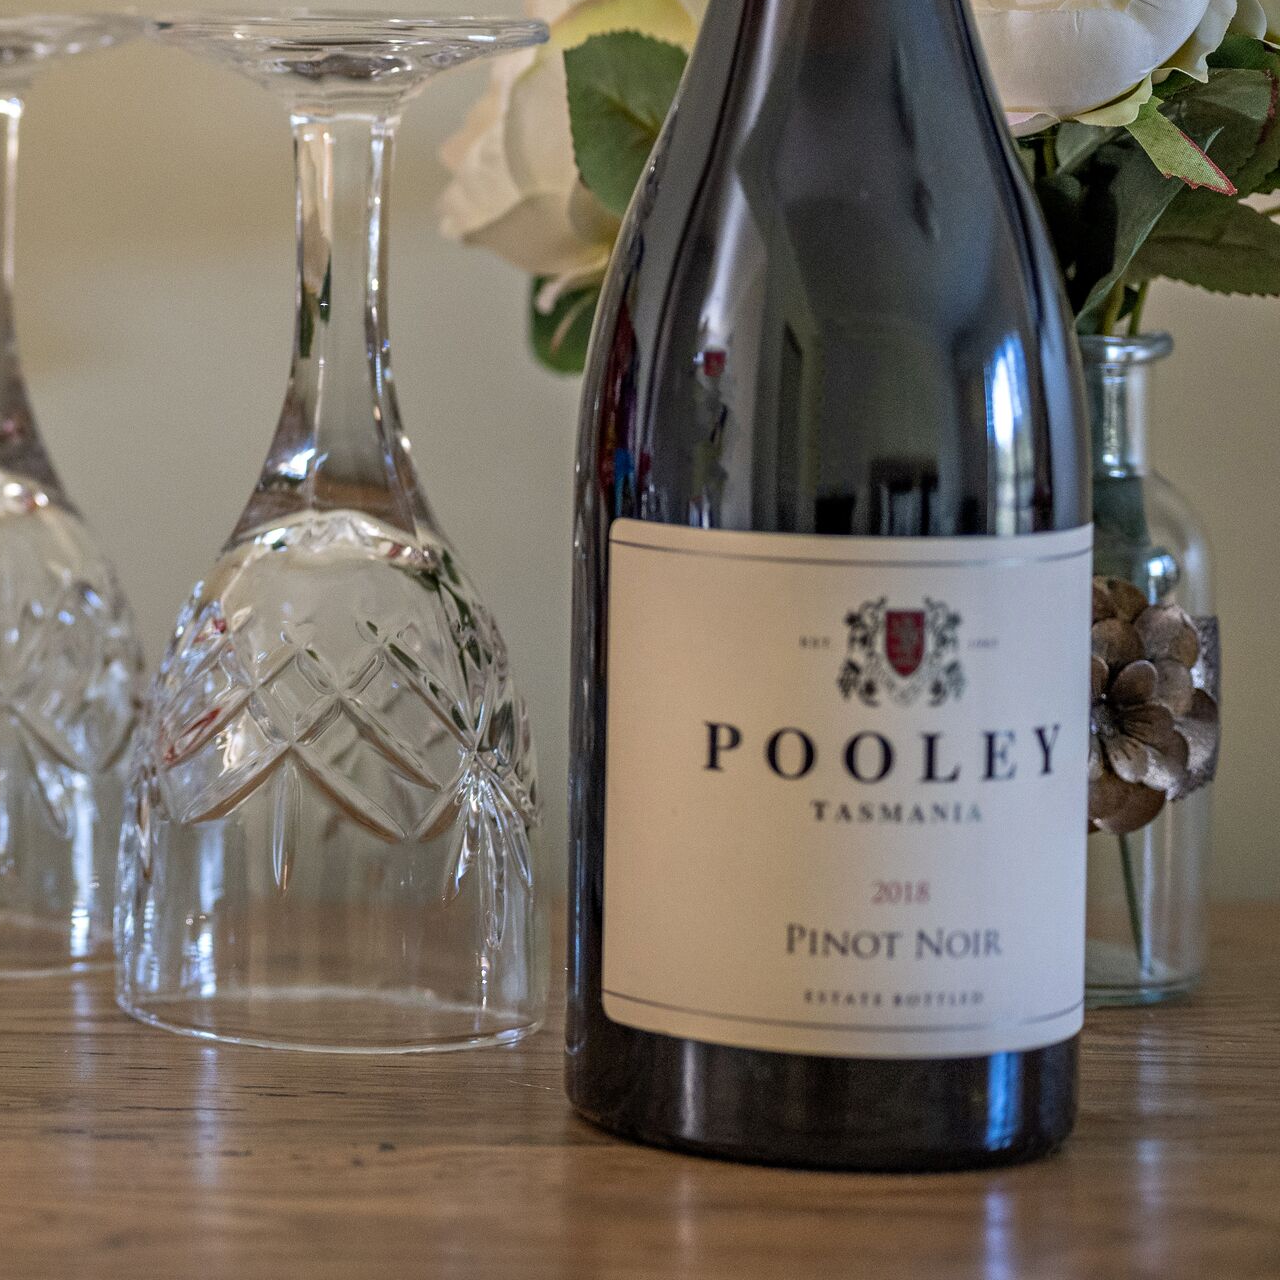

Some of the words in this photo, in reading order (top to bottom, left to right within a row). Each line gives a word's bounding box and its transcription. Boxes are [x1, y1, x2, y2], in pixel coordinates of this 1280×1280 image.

[703, 721, 1062, 784] POOLEY
[810, 800, 983, 824] TASMANIA
[871, 880, 931, 905] 2018
[785, 923, 903, 960] PINOT
[915, 926, 1003, 959] NOIR
